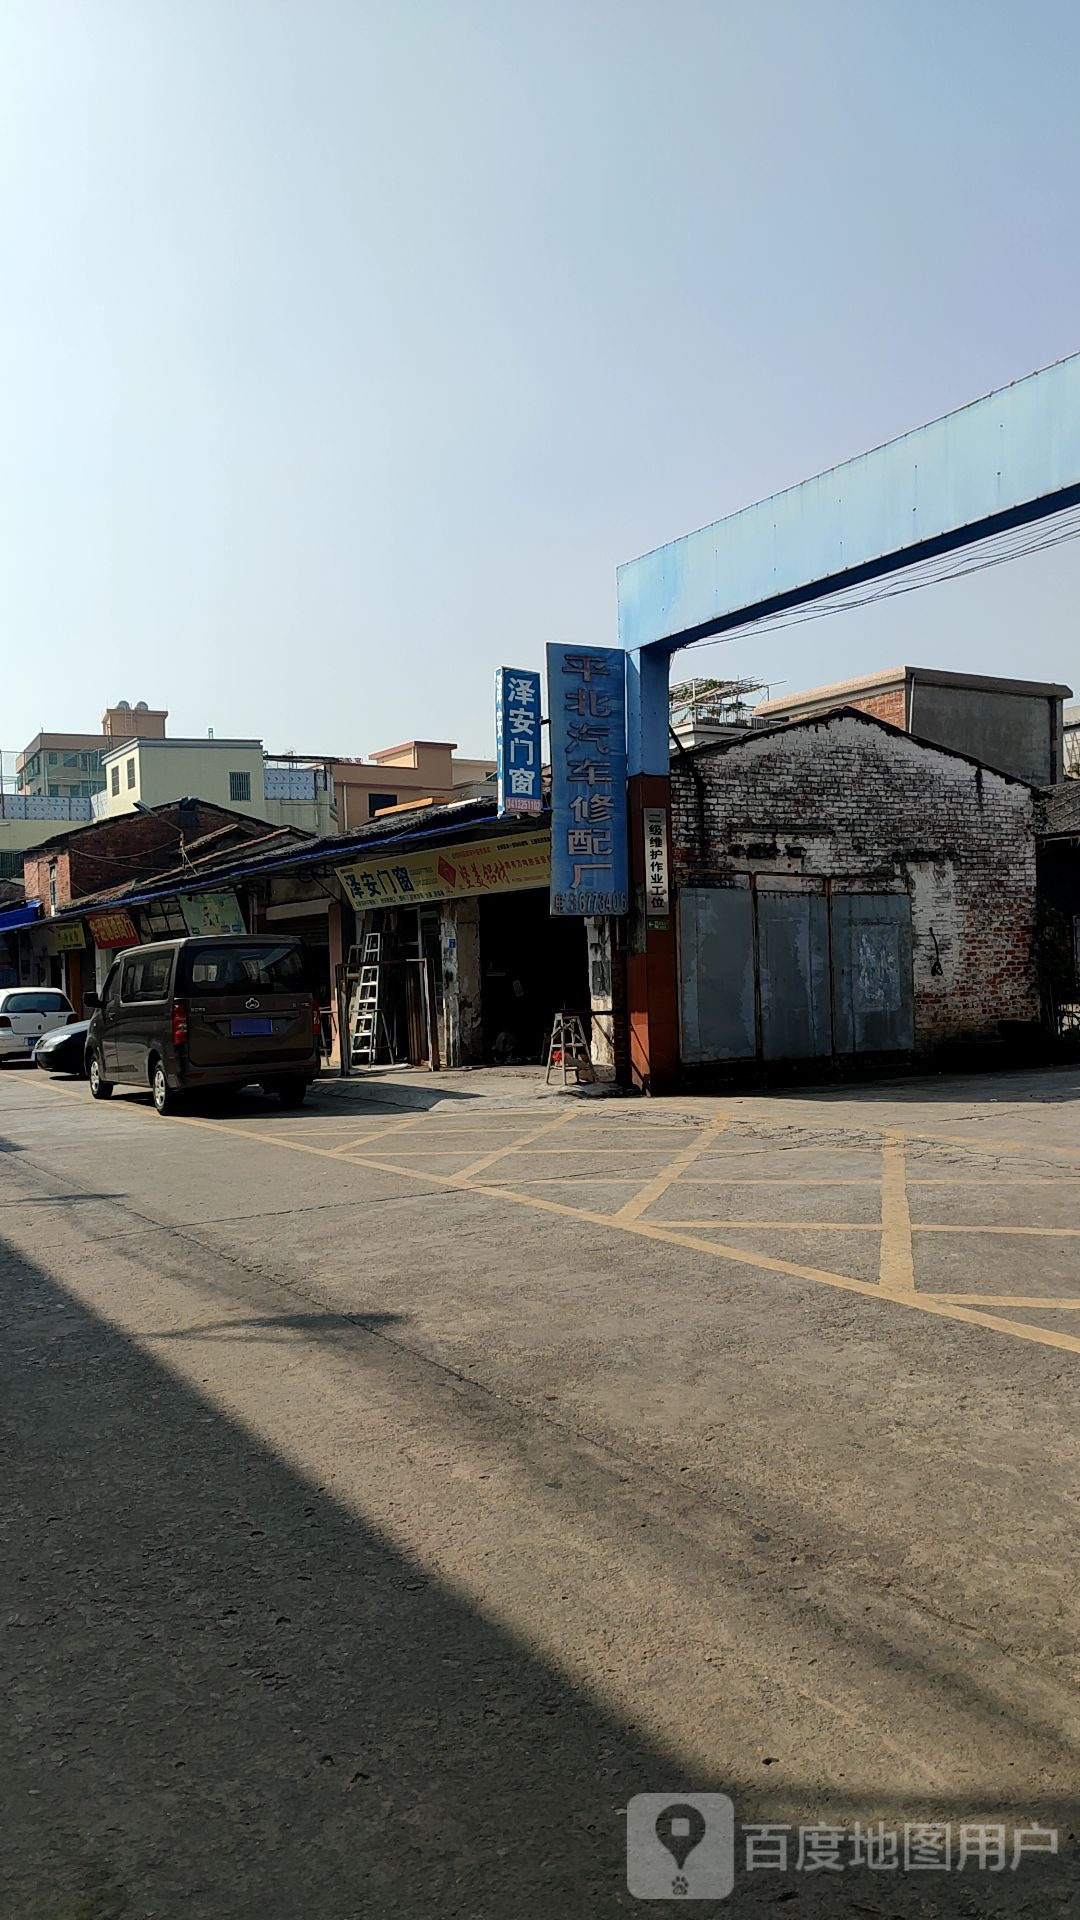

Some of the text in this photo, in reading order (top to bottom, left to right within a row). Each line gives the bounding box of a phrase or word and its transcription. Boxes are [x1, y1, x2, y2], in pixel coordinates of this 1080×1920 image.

[507, 676, 536, 796] 泽安门窗
[562, 654, 616, 890] 平北汽车修配厂
[343, 865, 415, 899] 泽安门窗
[648, 813, 665, 908] 二级维护作业工位
